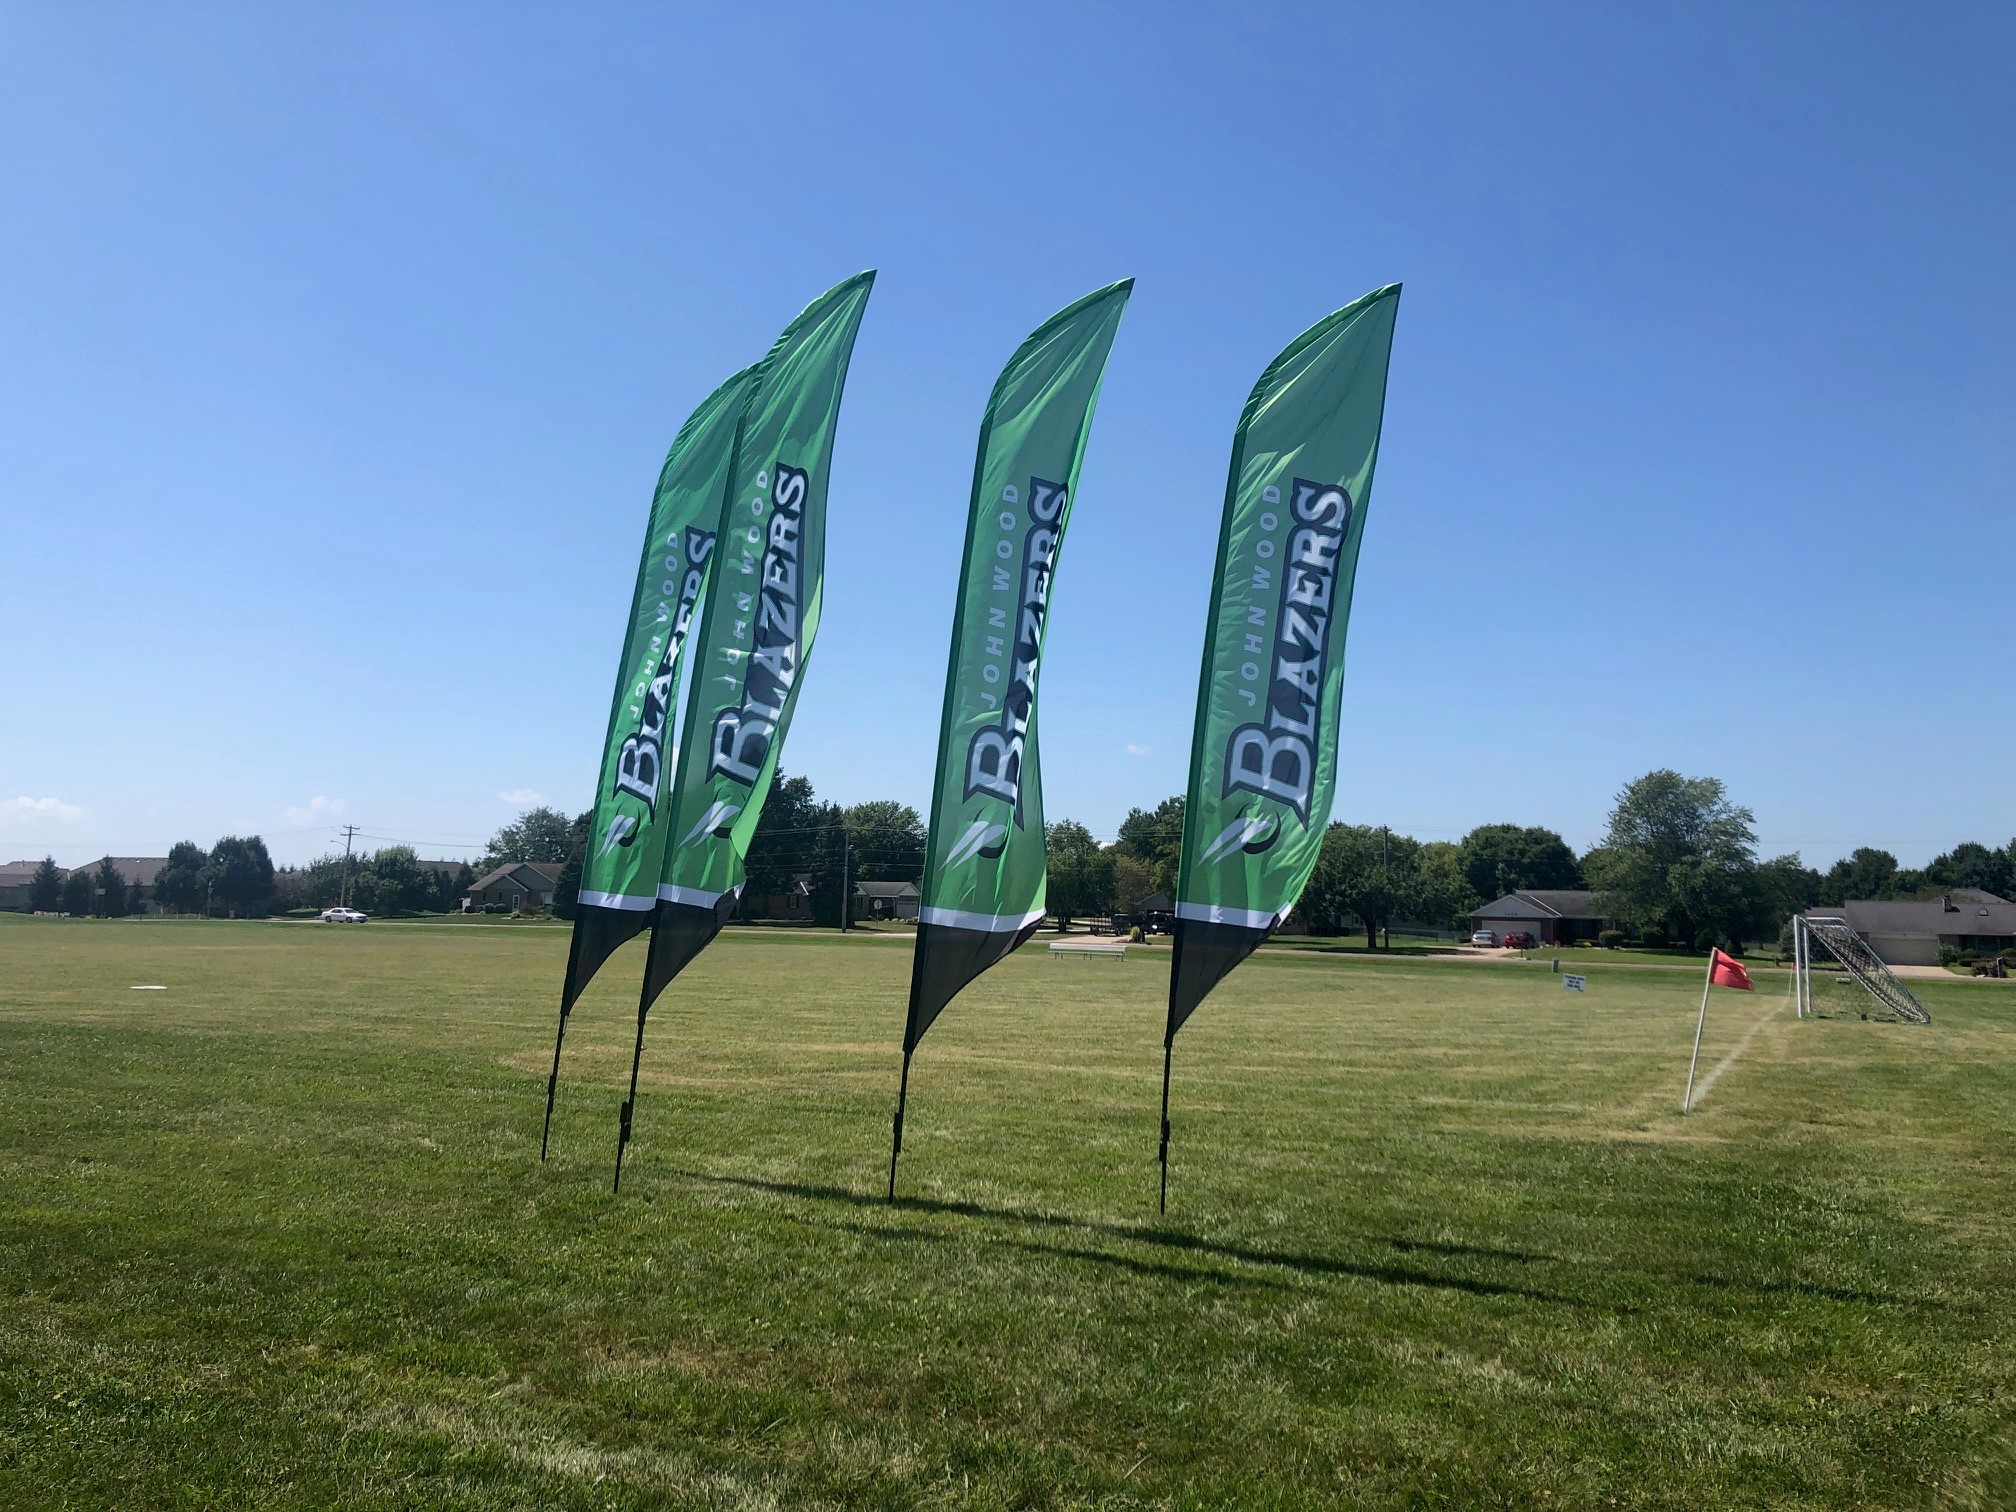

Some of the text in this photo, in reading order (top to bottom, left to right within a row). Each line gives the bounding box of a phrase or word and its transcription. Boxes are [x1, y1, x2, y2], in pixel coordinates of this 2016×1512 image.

[612, 526, 716, 820] BLAZERS
[630, 532, 679, 719] JOHN WOOD
[705, 463, 809, 786] BLAZERS
[724, 470, 768, 691] JOHN WOOD
[963, 477, 1068, 826] BLAZERS
[980, 484, 1018, 710] JOHN WOOD
[1223, 477, 1351, 830] BLAZERS
[1238, 485, 1280, 707] JOHN WOOD
